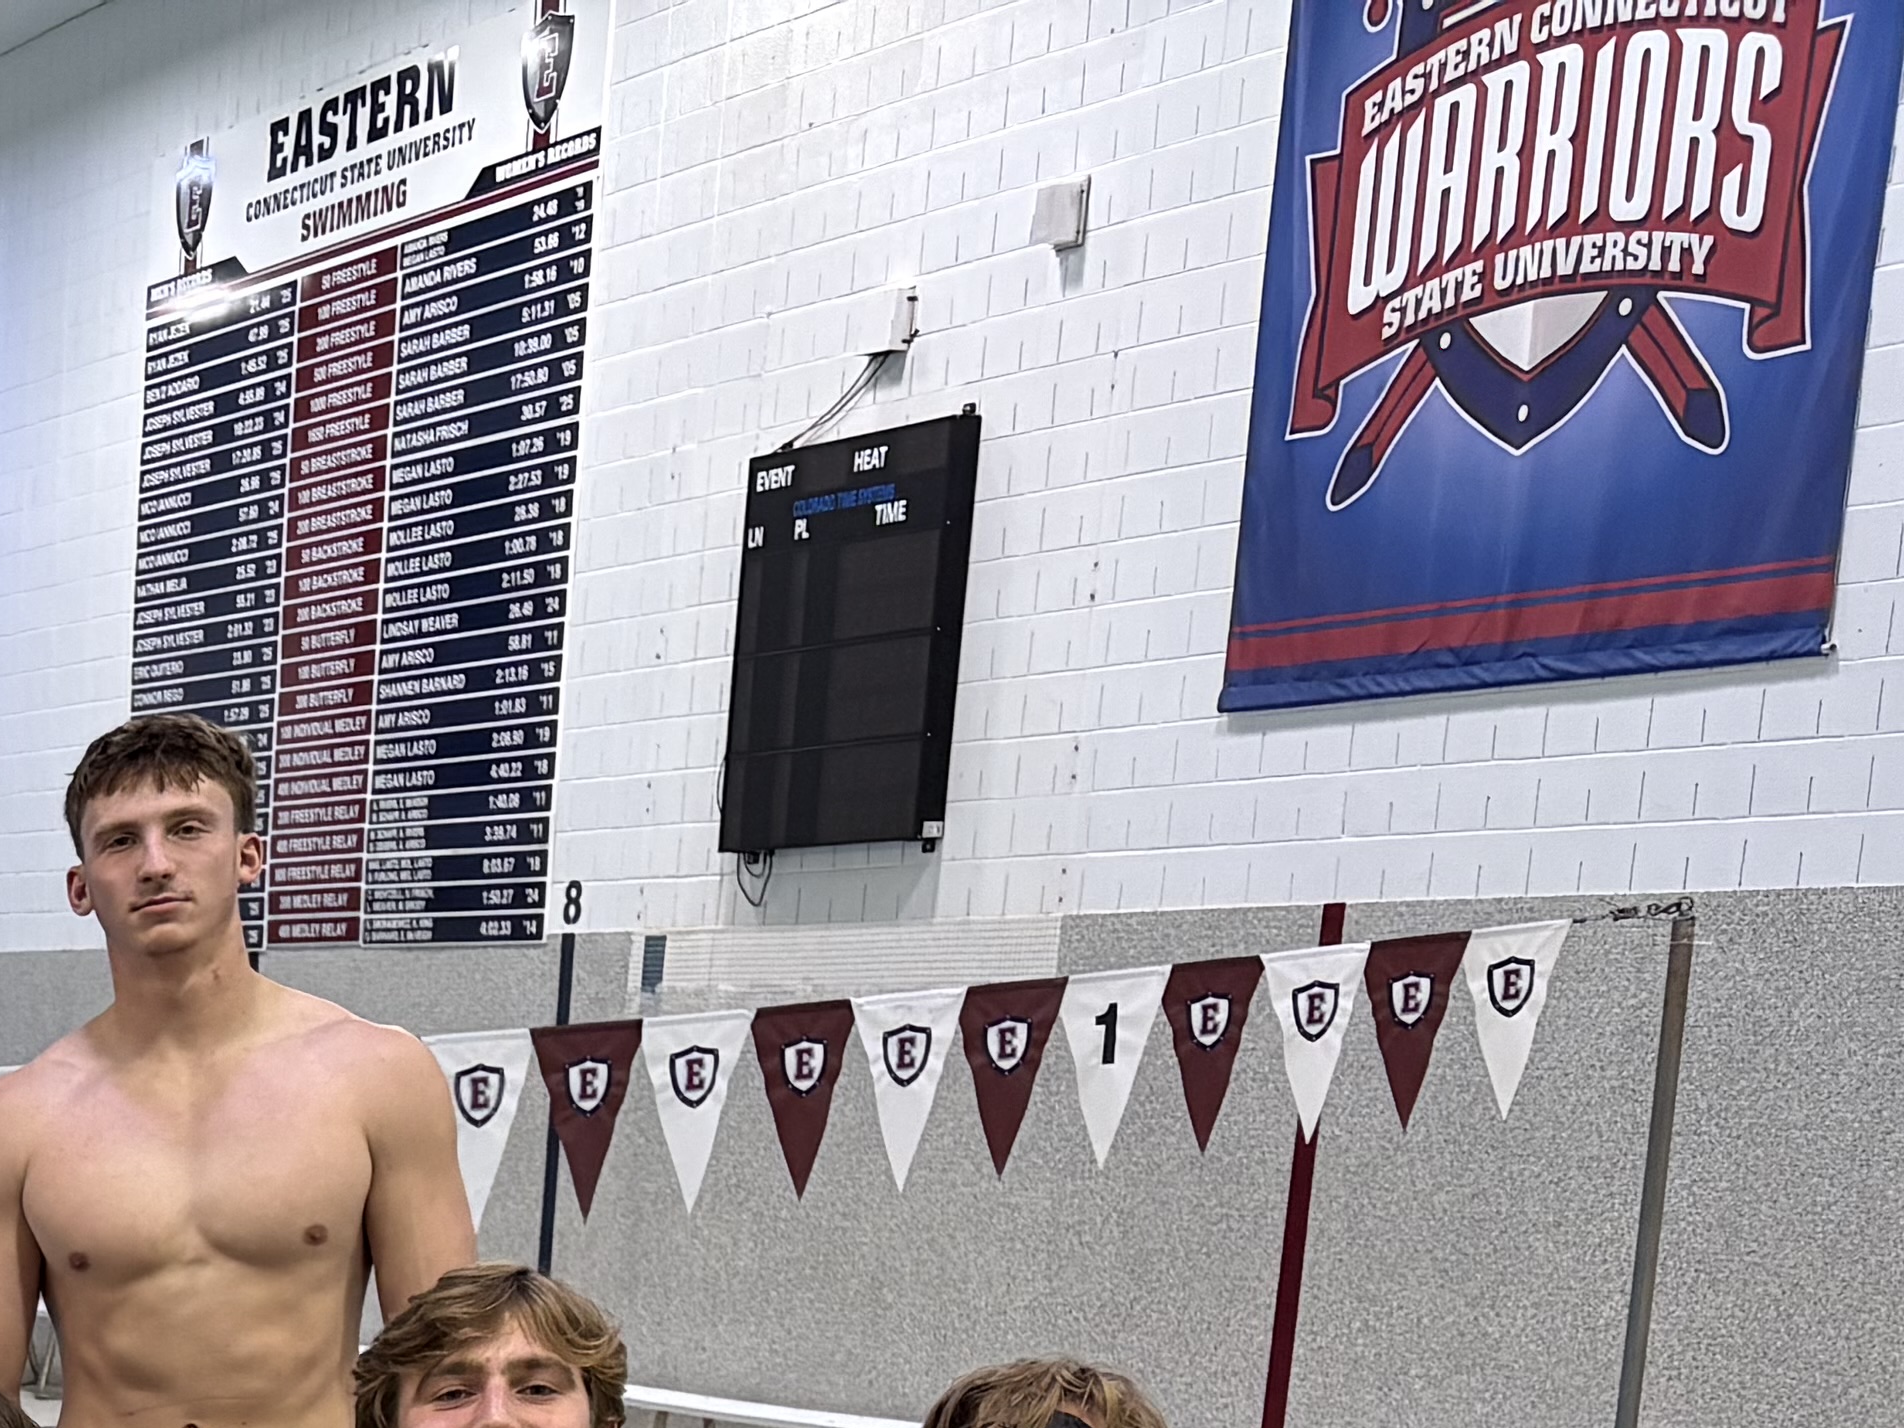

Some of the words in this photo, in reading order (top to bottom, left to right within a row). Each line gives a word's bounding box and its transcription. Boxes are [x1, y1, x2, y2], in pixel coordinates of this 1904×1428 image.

[1362, 11, 1522, 137] EASTERN
[267, 45, 459, 182] EASTERN
[245, 171, 337, 222] CONNECTICUT
[340, 160, 382, 195] STATE
[386, 118, 476, 176] UNIVERSITY
[1347, 27, 1784, 316] WARRIORS
[300, 177, 408, 243] SWIMMING
[1381, 261, 1483, 341] STATE
[1492, 232, 1715, 291] UNIVERSITY
[756, 465, 795, 492] EVENT
[853, 446, 888, 472] HEAT
[748, 526, 764, 549] LN
[794, 518, 810, 540] PL
[875, 500, 907, 525] TIME
[563, 880, 582, 925] 8
[1402, 983, 1421, 1013] E
[1502, 970, 1522, 1001] E
[1200, 1003, 1220, 1035] E
[1307, 993, 1326, 1025] E
[897, 1036, 917, 1070] E
[997, 1027, 1017, 1058] E
[1095, 1003, 1119, 1065] 1
[685, 1059, 705, 1092] E
[796, 1047, 816, 1080] E
[471, 1077, 491, 1110] E
[579, 1067, 599, 1100] E
